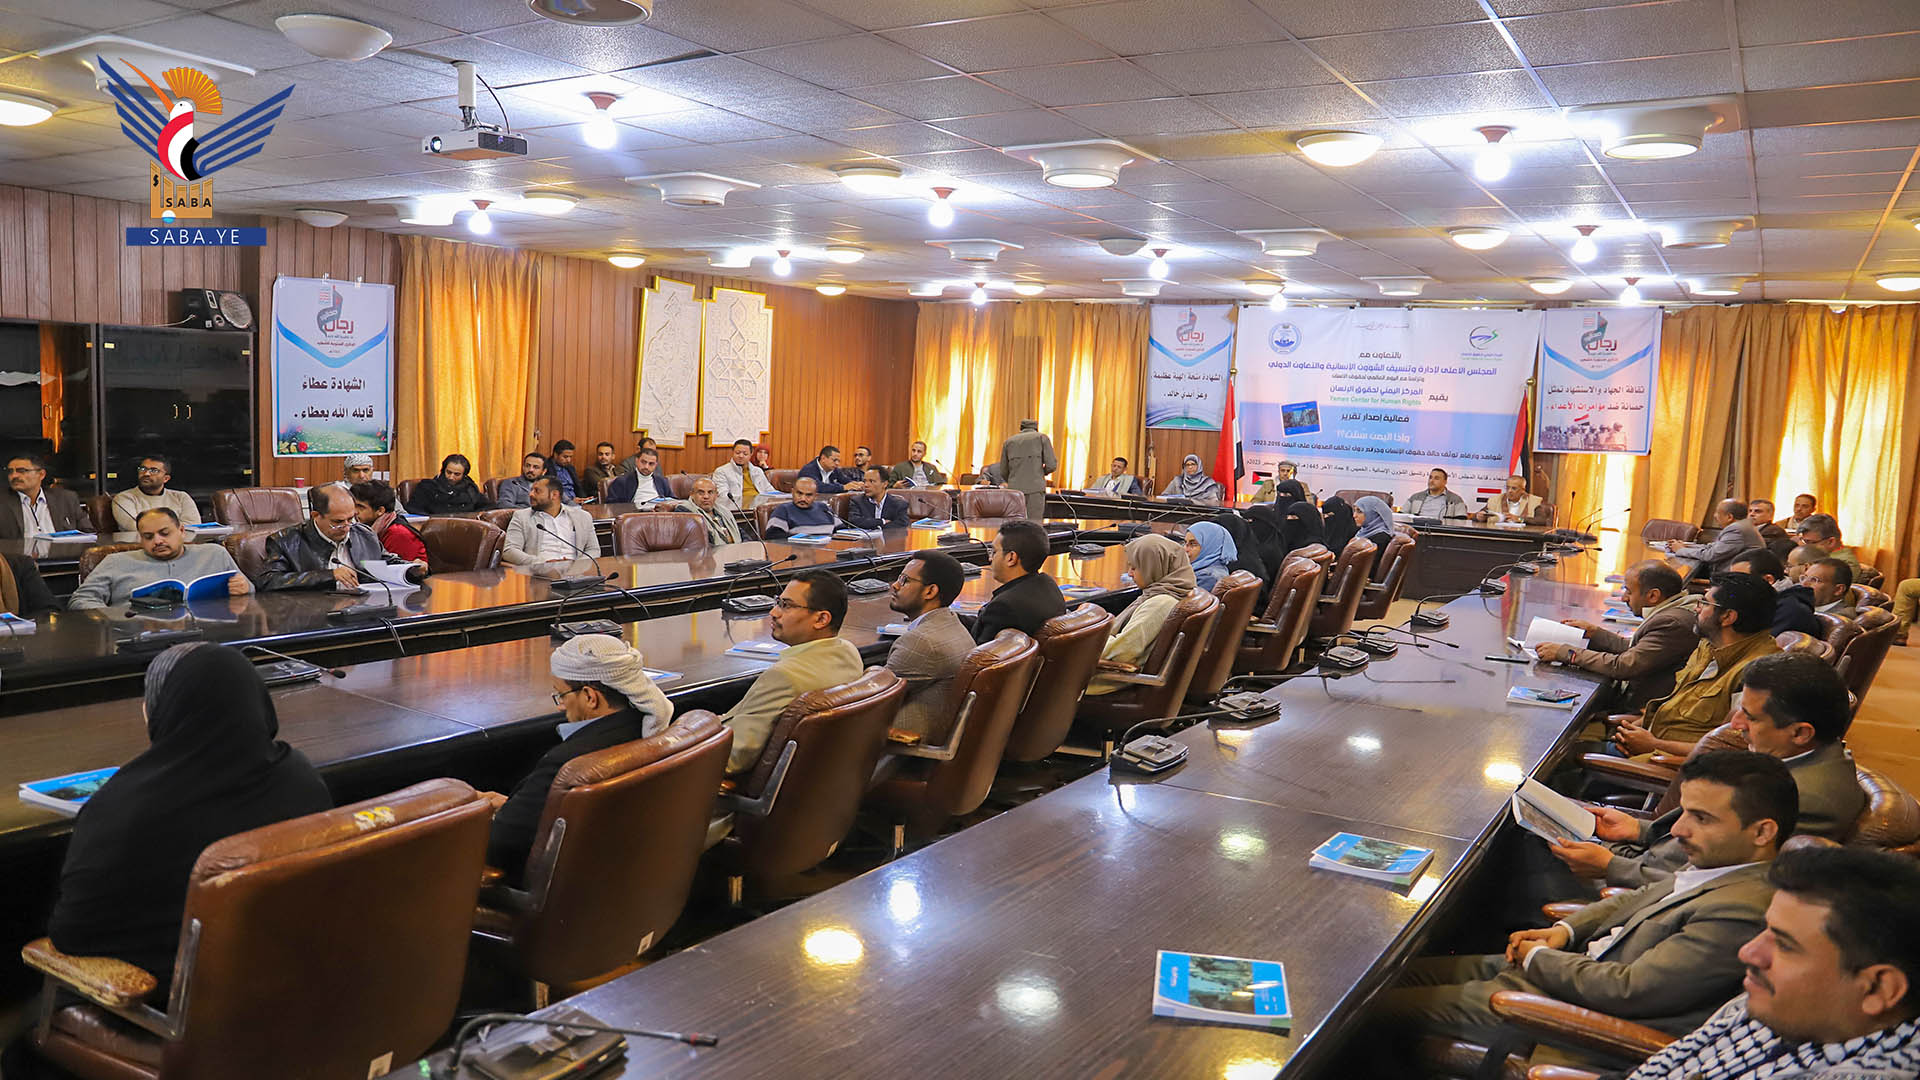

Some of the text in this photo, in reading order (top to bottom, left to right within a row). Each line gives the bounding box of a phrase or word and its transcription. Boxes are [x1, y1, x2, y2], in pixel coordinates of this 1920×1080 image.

[324, 318, 354, 334] رجال
[1587, 339, 1617, 351] رجال
[1371, 351, 1402, 360] بالتعاون
[1292, 360, 1325, 370] والتعاون
[1467, 367, 1497, 376] المجلس
[331, 376, 366, 392] الشهادة
[1355, 385, 1379, 394] لحقوق
[1380, 386, 1401, 396] اليمني
[1401, 386, 1423, 396] المركز
[1428, 393, 1449, 403] يقيم
[332, 404, 349, 418] الله
[352, 404, 374, 422] قابله
[1342, 412, 1362, 422] تقرير
[1383, 413, 1410, 423] فعالية
